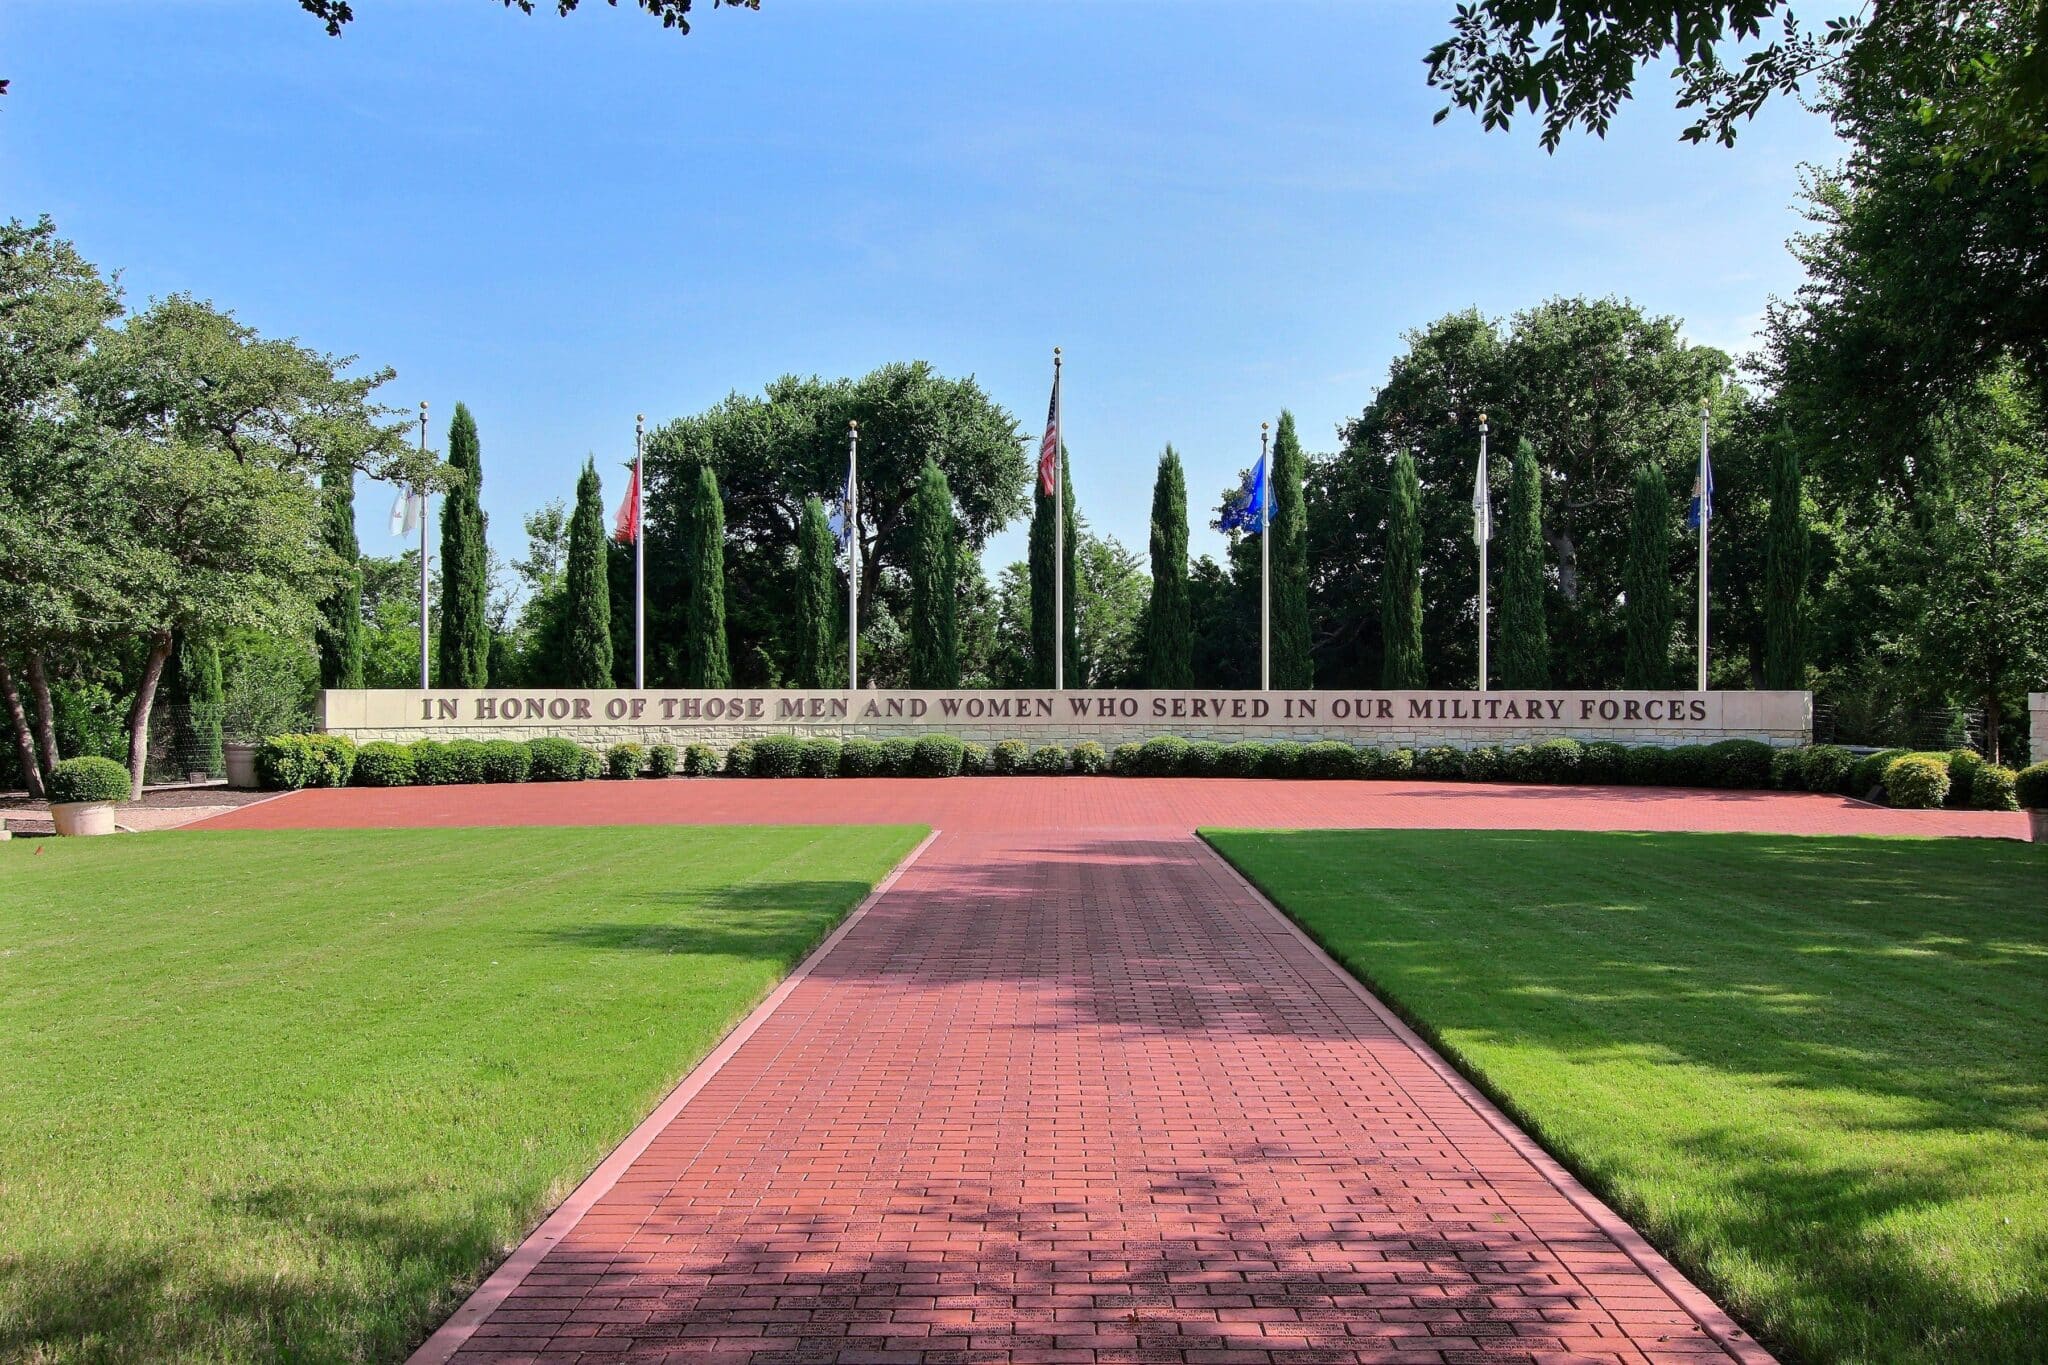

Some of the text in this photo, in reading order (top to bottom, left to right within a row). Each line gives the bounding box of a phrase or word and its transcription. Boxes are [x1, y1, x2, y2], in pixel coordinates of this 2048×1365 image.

[422, 697, 1707, 721] IN HONOR OF THOSE MEN AND WOMEN WHO SERVED IN OUR MILITARY FORCES
